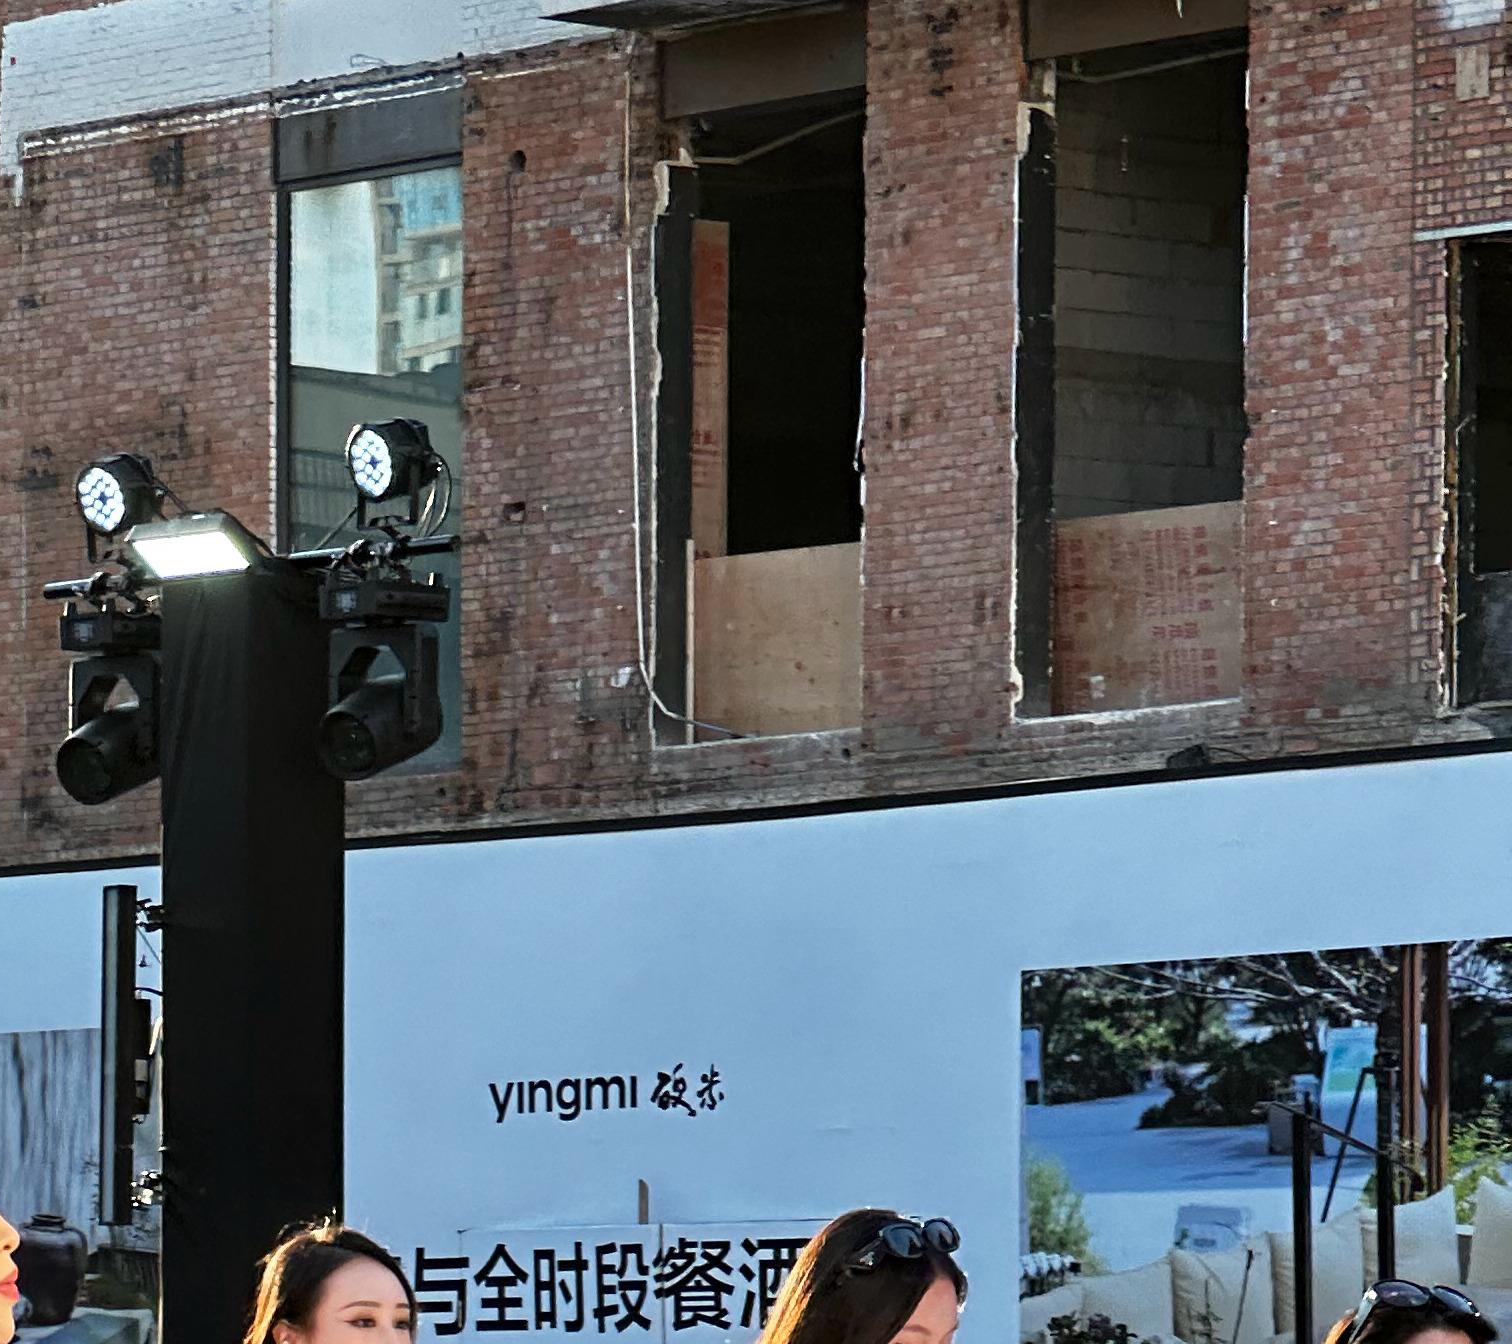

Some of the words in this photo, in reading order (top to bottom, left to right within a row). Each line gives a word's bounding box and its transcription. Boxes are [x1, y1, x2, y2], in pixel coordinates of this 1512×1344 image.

[488, 1074, 639, 1124] yingmi
[412, 1236, 812, 1337] 与全时段餐酒
